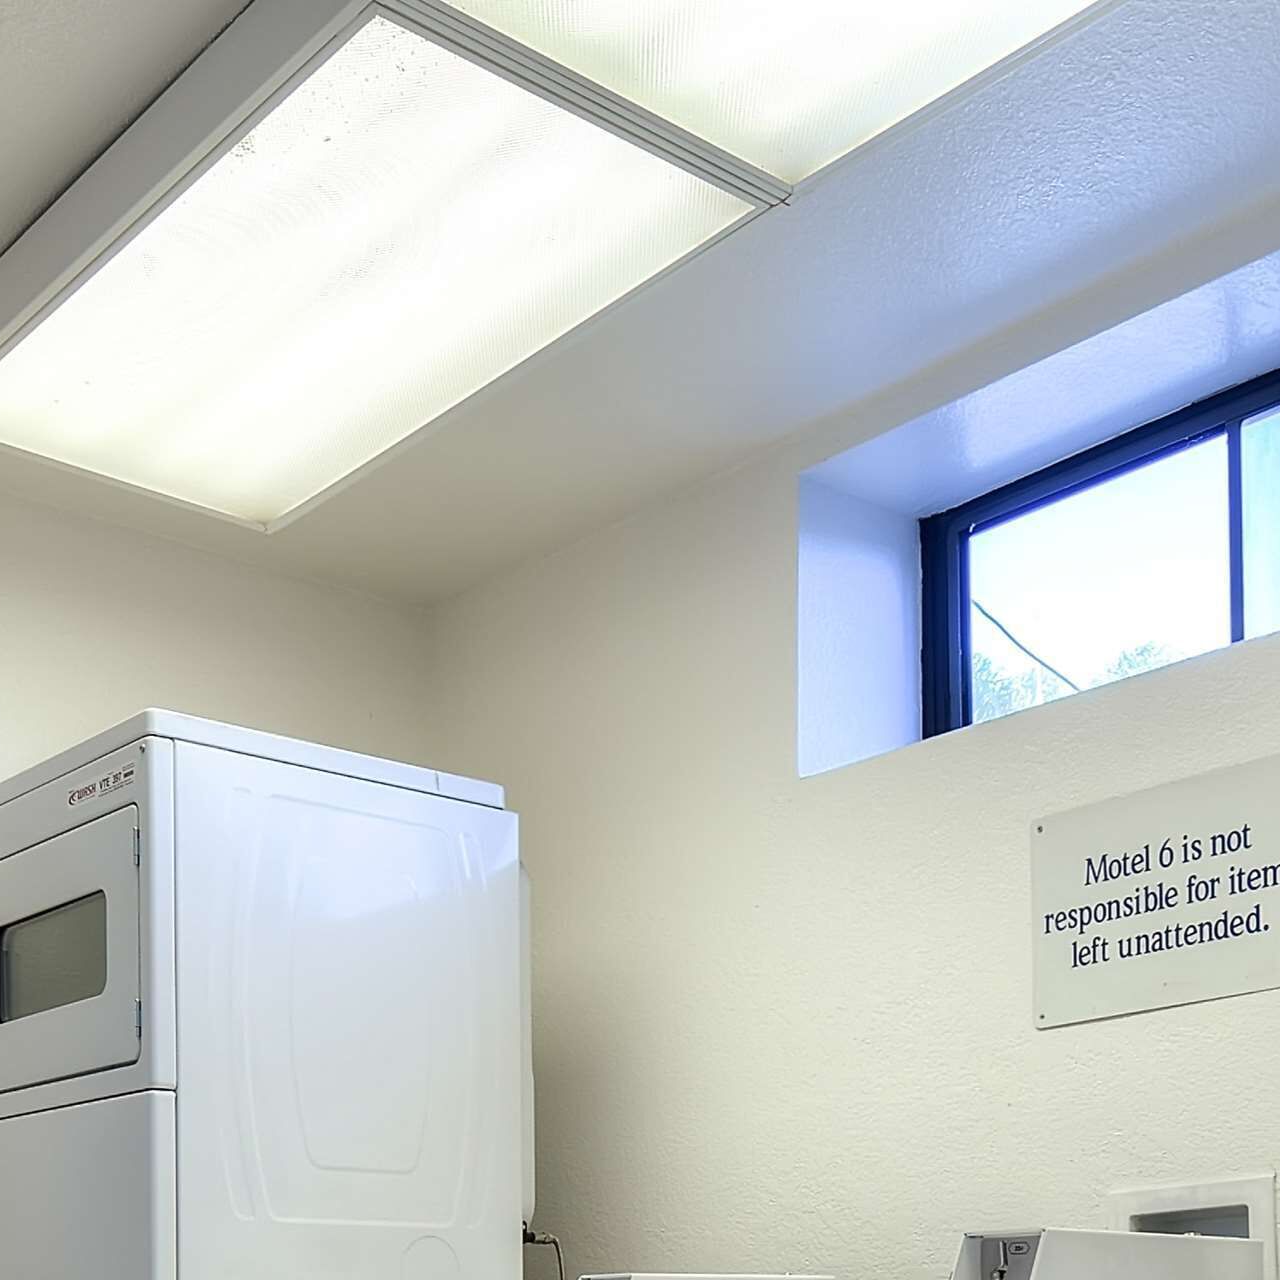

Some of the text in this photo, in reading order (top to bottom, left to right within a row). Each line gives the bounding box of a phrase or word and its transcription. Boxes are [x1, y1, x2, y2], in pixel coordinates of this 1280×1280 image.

[1084, 823, 1252, 886] Motel 6 is not
[1044, 882, 1179, 935] responsible
[1186, 874, 1221, 905] for
[1071, 904, 1270, 969] left unattended.
